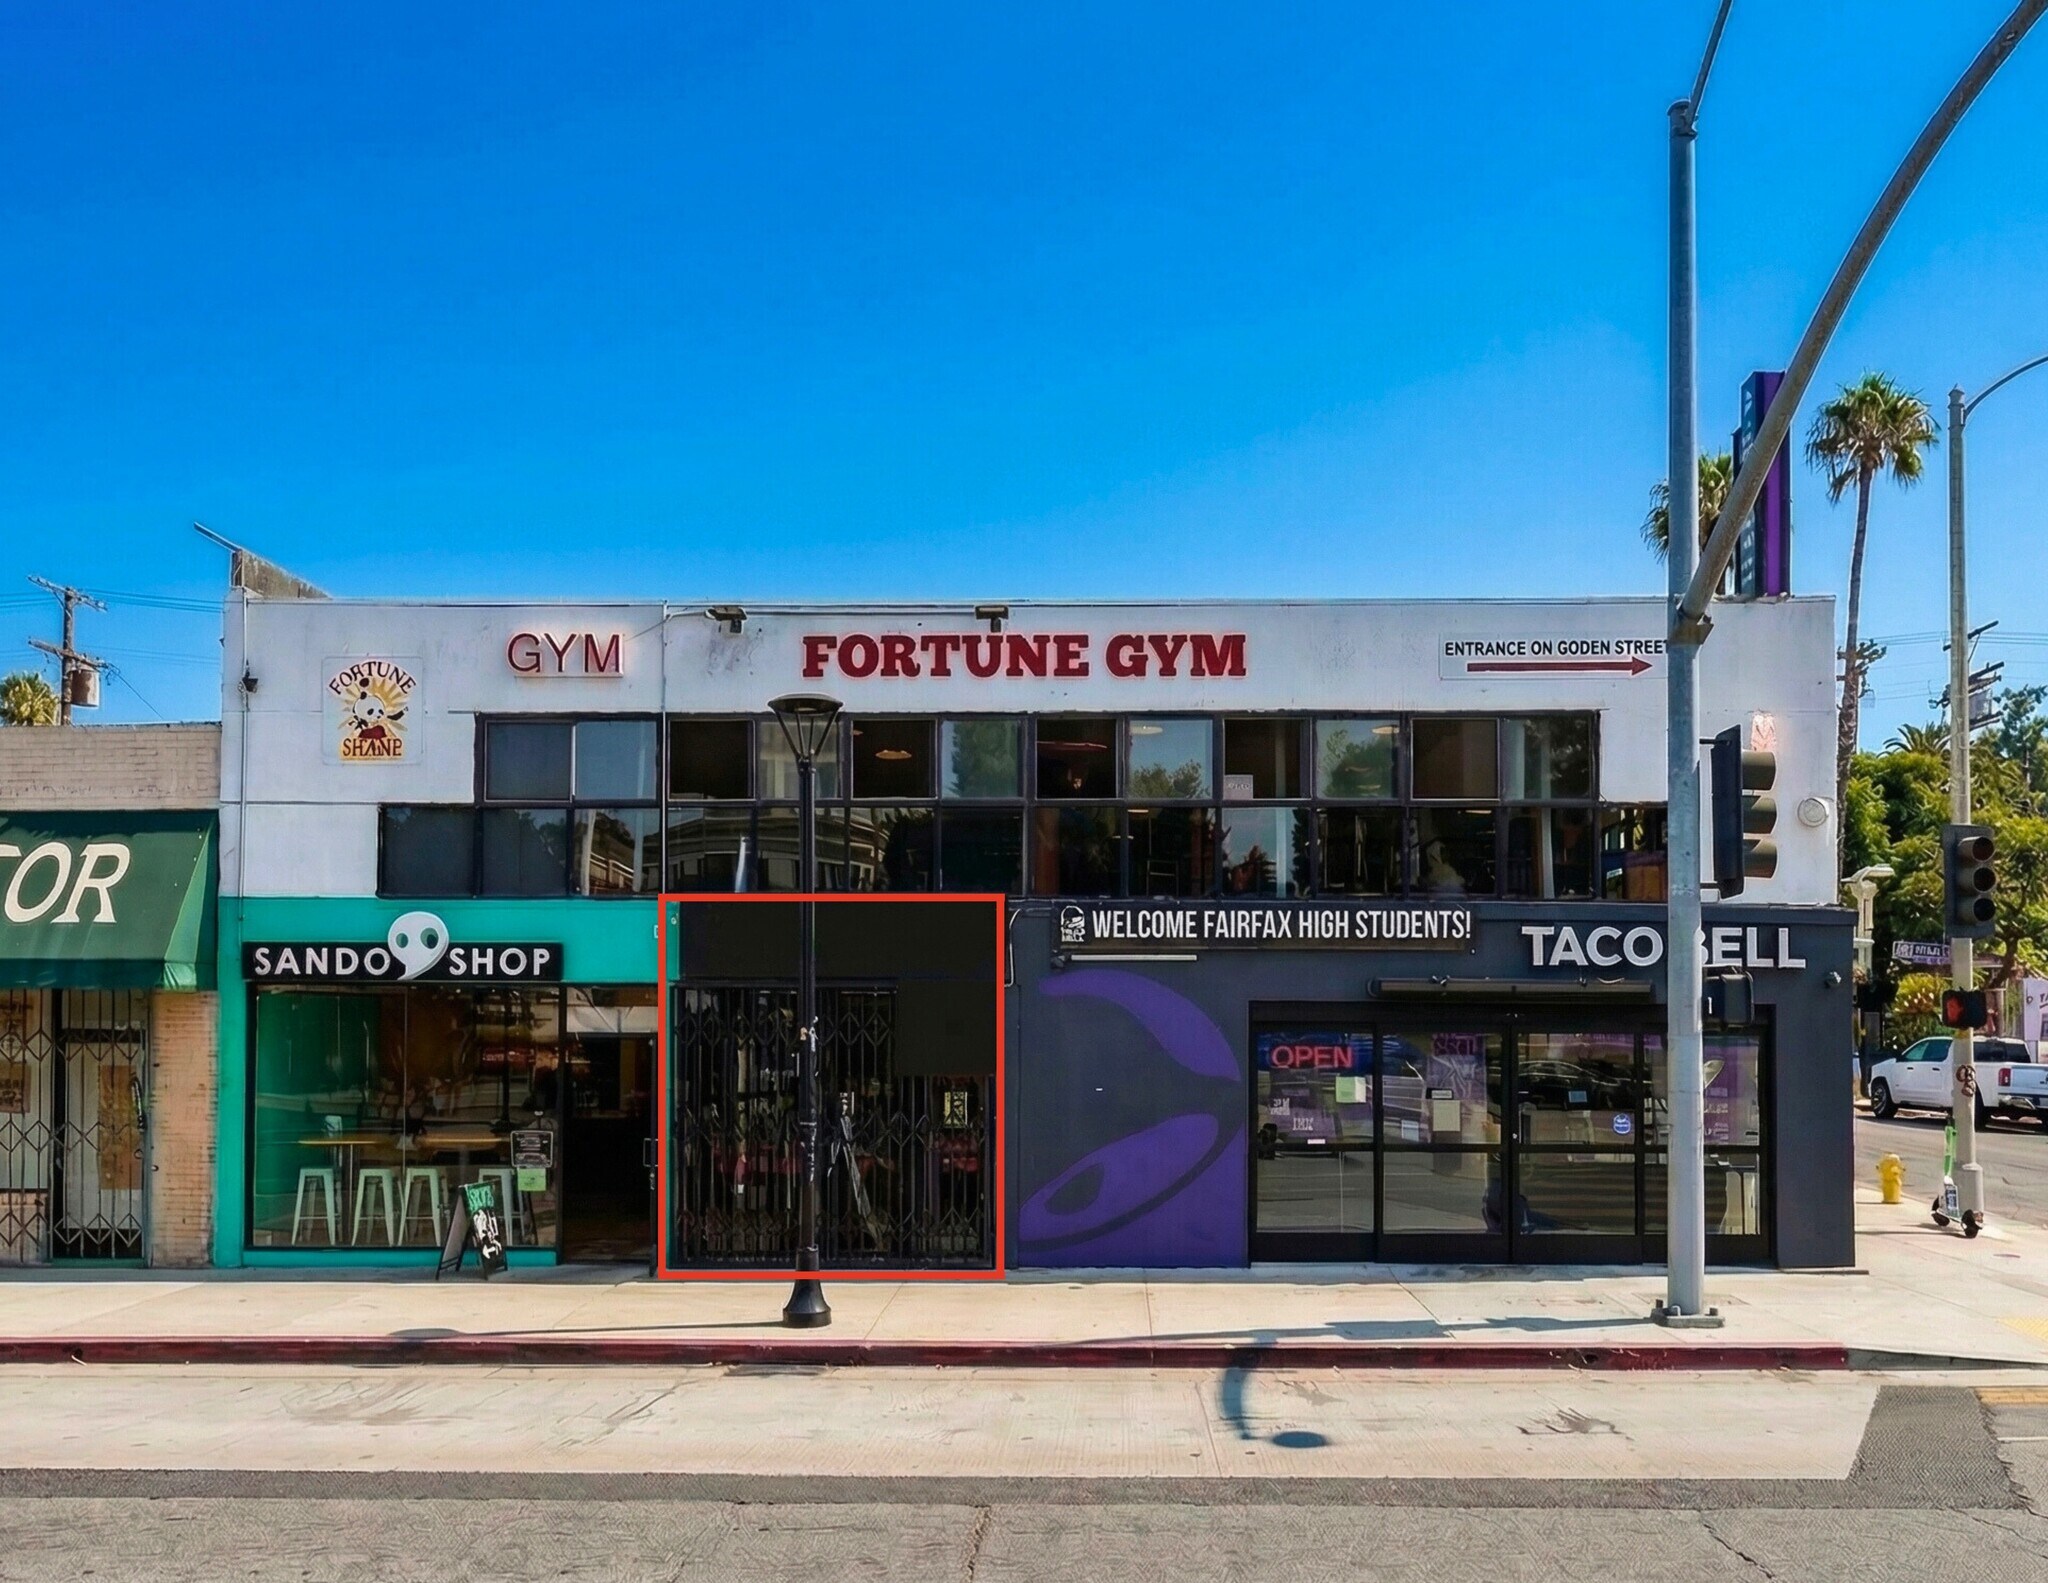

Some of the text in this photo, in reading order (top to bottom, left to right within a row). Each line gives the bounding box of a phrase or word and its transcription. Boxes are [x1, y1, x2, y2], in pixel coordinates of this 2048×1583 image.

[507, 632, 621, 673] GYM
[803, 634, 1248, 679] FORTUNE GYM
[1445, 640, 1527, 656] ENTRANCE
[1531, 640, 1553, 655] ON
[1557, 640, 1611, 655] GODEN
[328, 661, 417, 695] FORTUNE
[0, 841, 131, 923] OR
[1092, 910, 1198, 938] WELCOME
[1203, 910, 1292, 938] FAIRFAX
[1298, 910, 1349, 938] HIGH
[1354, 910, 1471, 939] STUDENTS!
[255, 947, 551, 976] SANDO SHOP
[1521, 926, 1664, 967] TACO
[1271, 1045, 1352, 1069] OPEN
